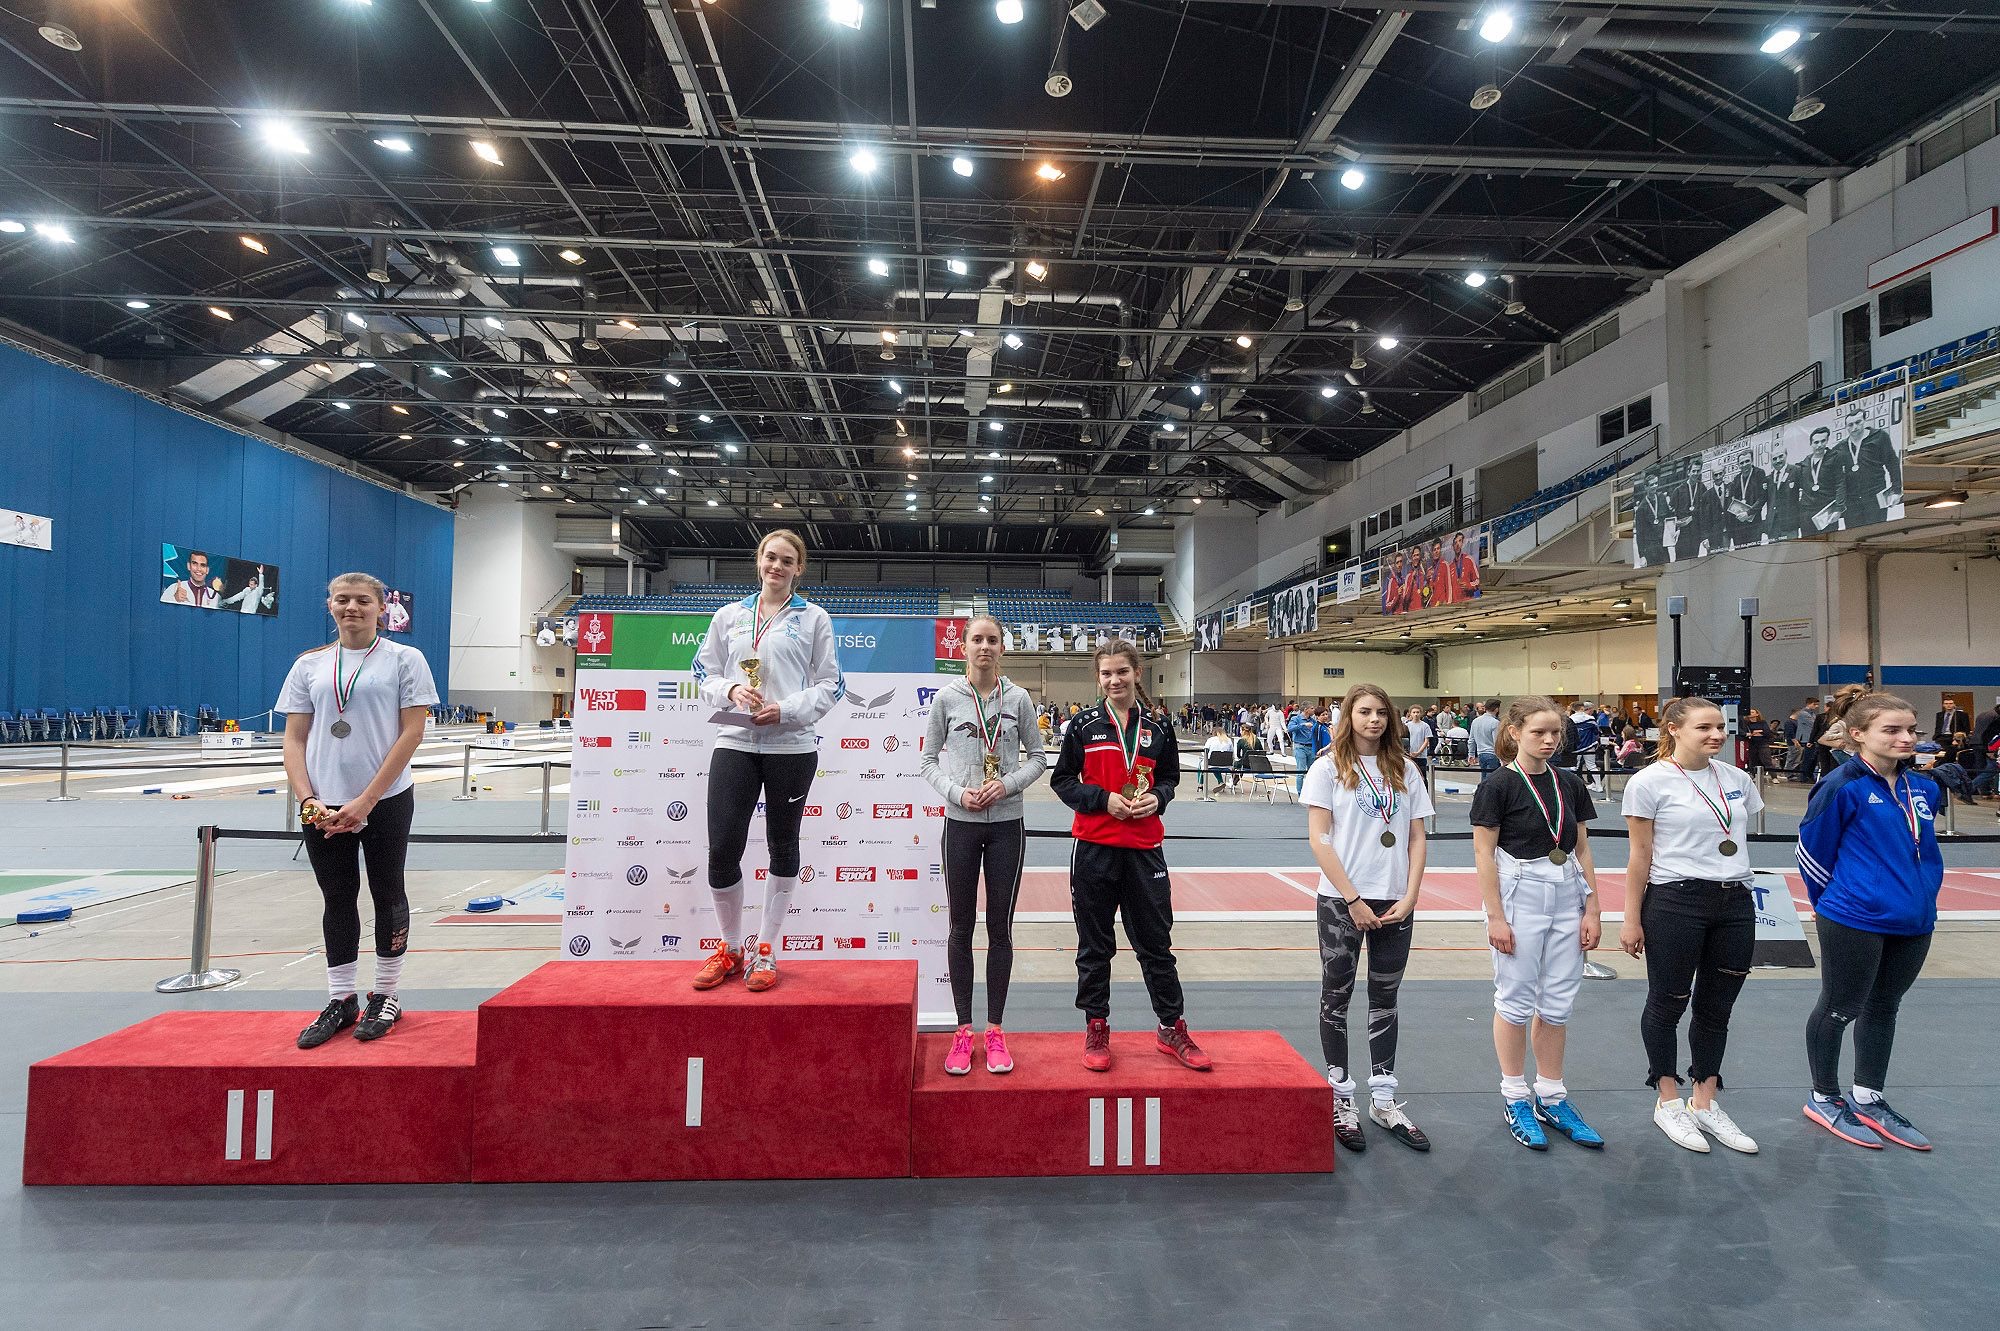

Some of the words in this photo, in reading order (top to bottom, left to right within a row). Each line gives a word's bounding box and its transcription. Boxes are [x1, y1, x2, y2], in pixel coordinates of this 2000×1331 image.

[580, 689, 616, 700] WEST
[587, 700, 615, 711] END
[842, 739, 868, 749] XIXO
[875, 808, 909, 818] sport
[838, 870, 873, 882] sport
[661, 935, 682, 946] PBT
[784, 938, 820, 951] sport
[686, 1057, 703, 1127] I
[225, 1089, 274, 1160] II
[1089, 1097, 1160, 1166] III
